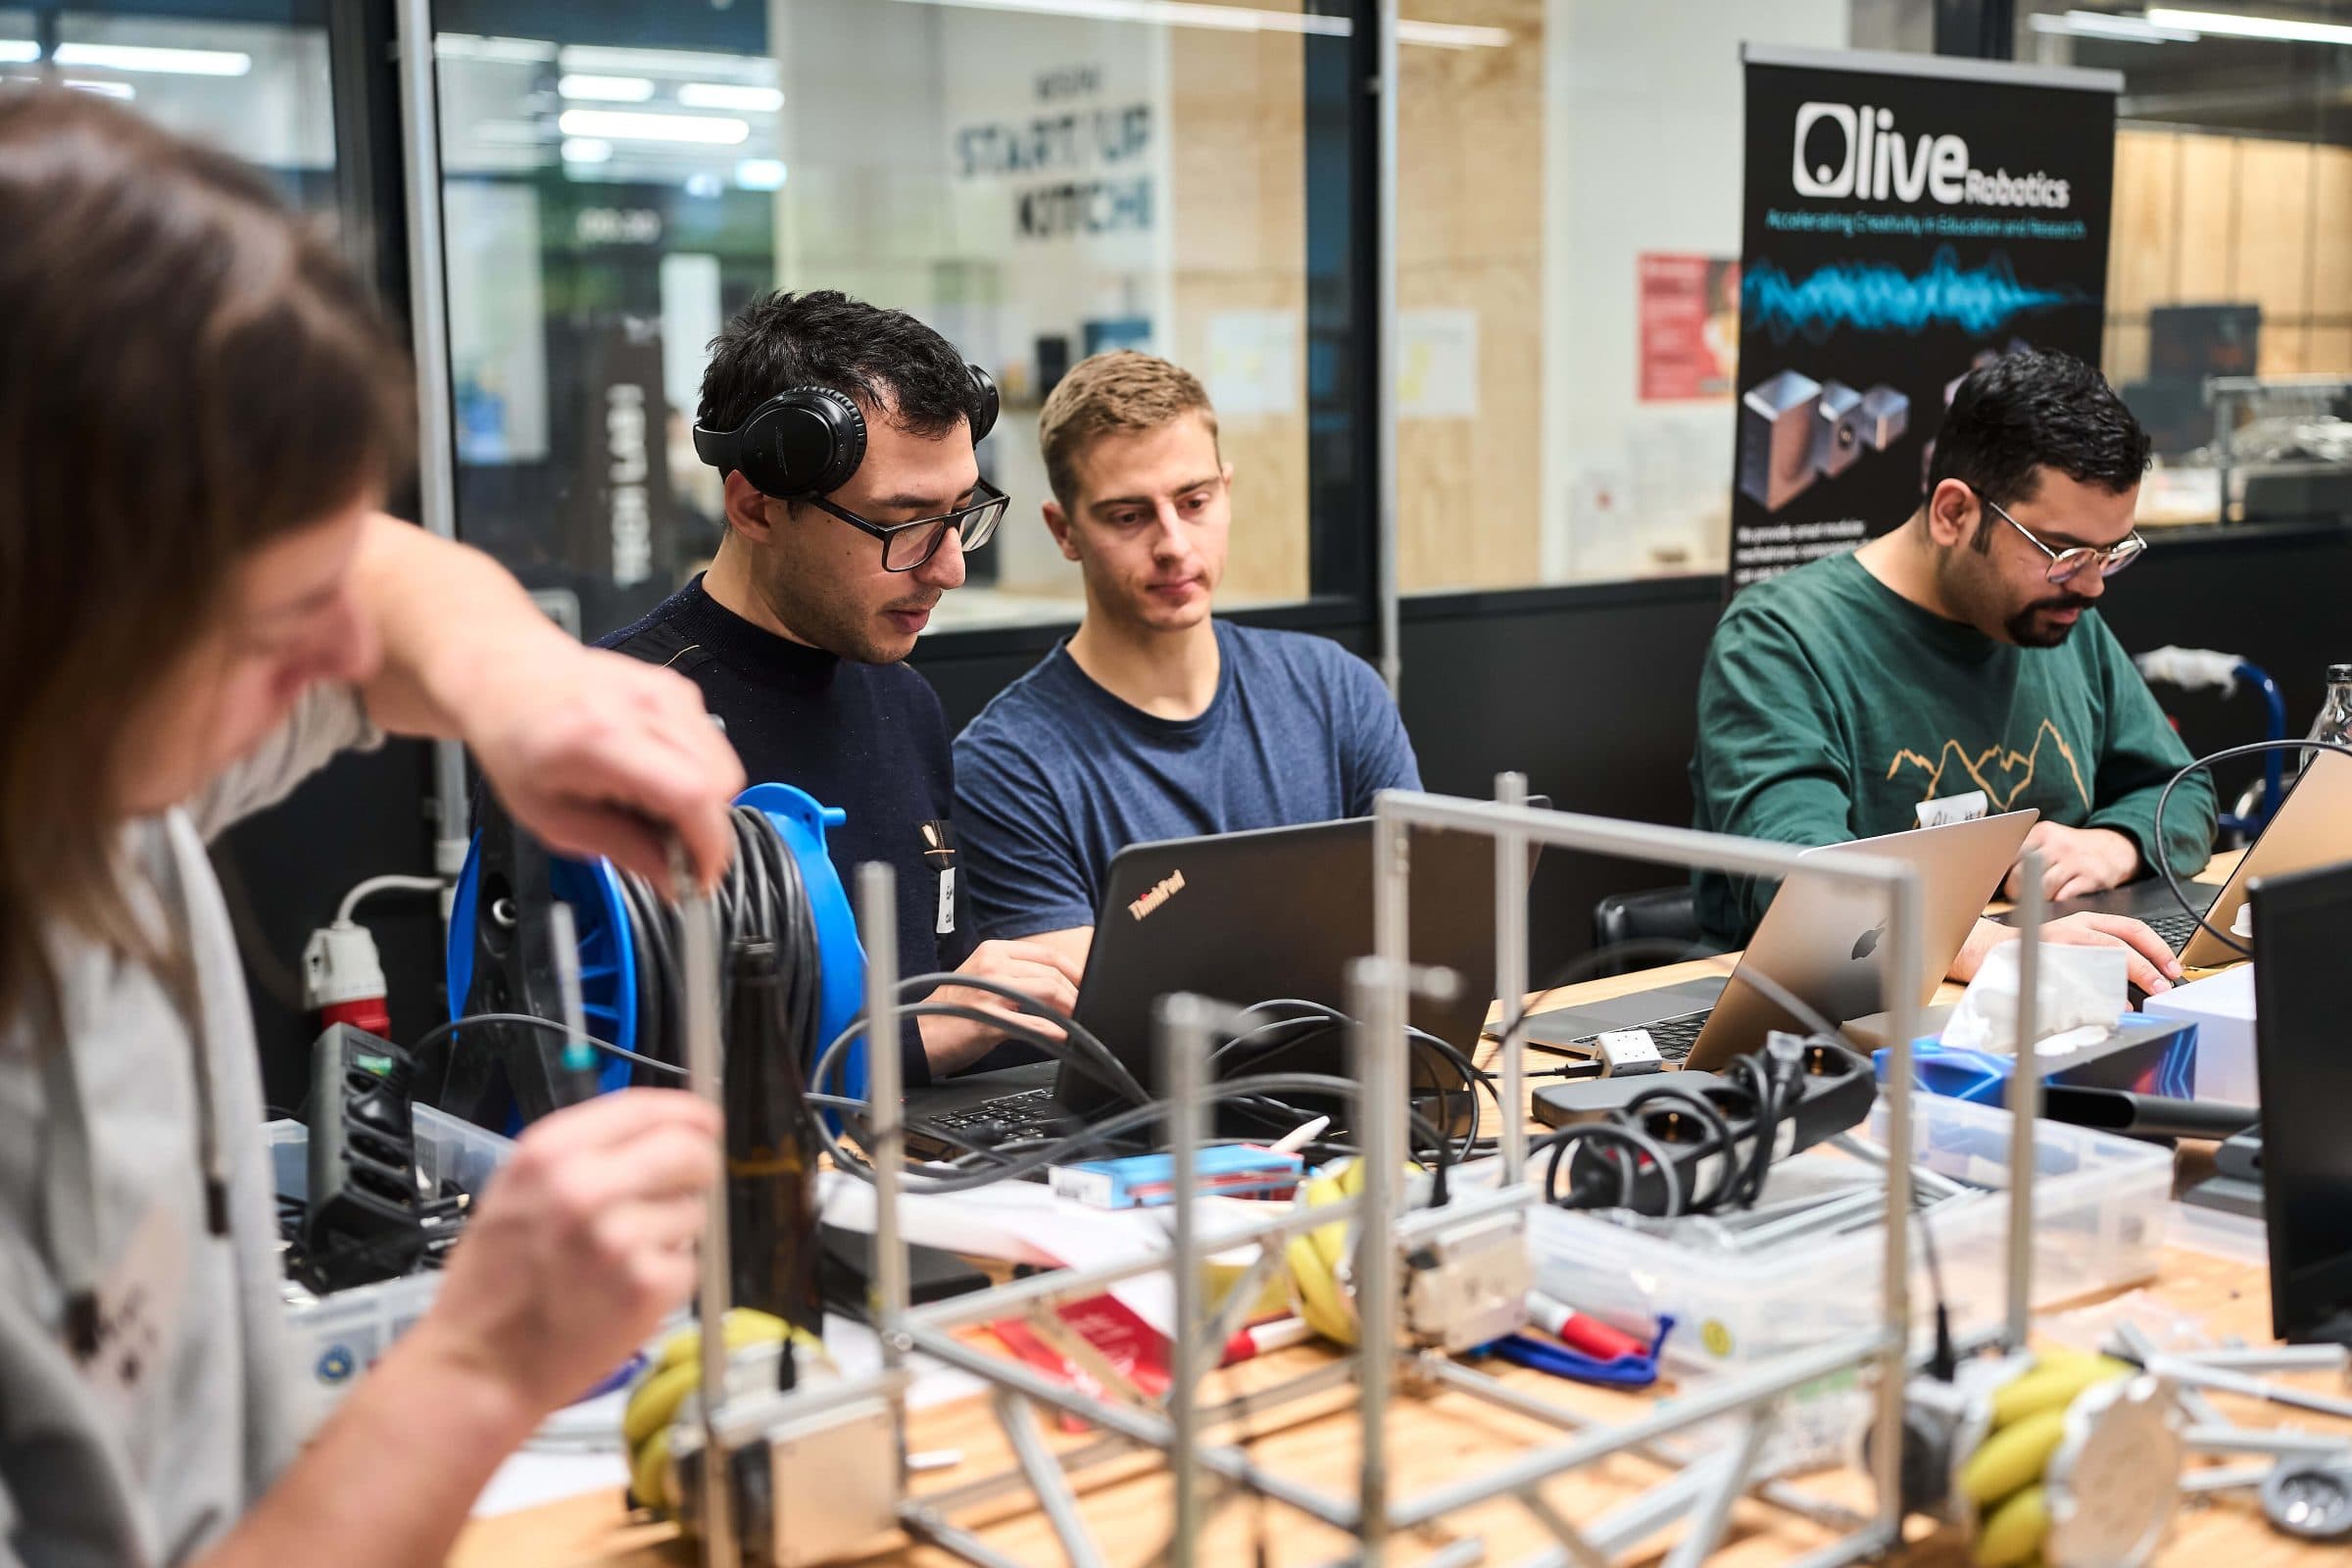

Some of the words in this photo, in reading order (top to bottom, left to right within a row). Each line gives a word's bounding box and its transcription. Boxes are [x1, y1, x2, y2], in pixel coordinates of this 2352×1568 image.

[1792, 101, 1969, 205] Olive
[1966, 168, 2072, 209] Robotics
[1765, 209, 1854, 237] Accelerating
[1855, 212, 1922, 238] Creativity
[1936, 215, 2001, 236] Education
[2003, 218, 2027, 236] and
[2029, 218, 2086, 239] Research
[1128, 869, 1186, 921] ThinkPad
